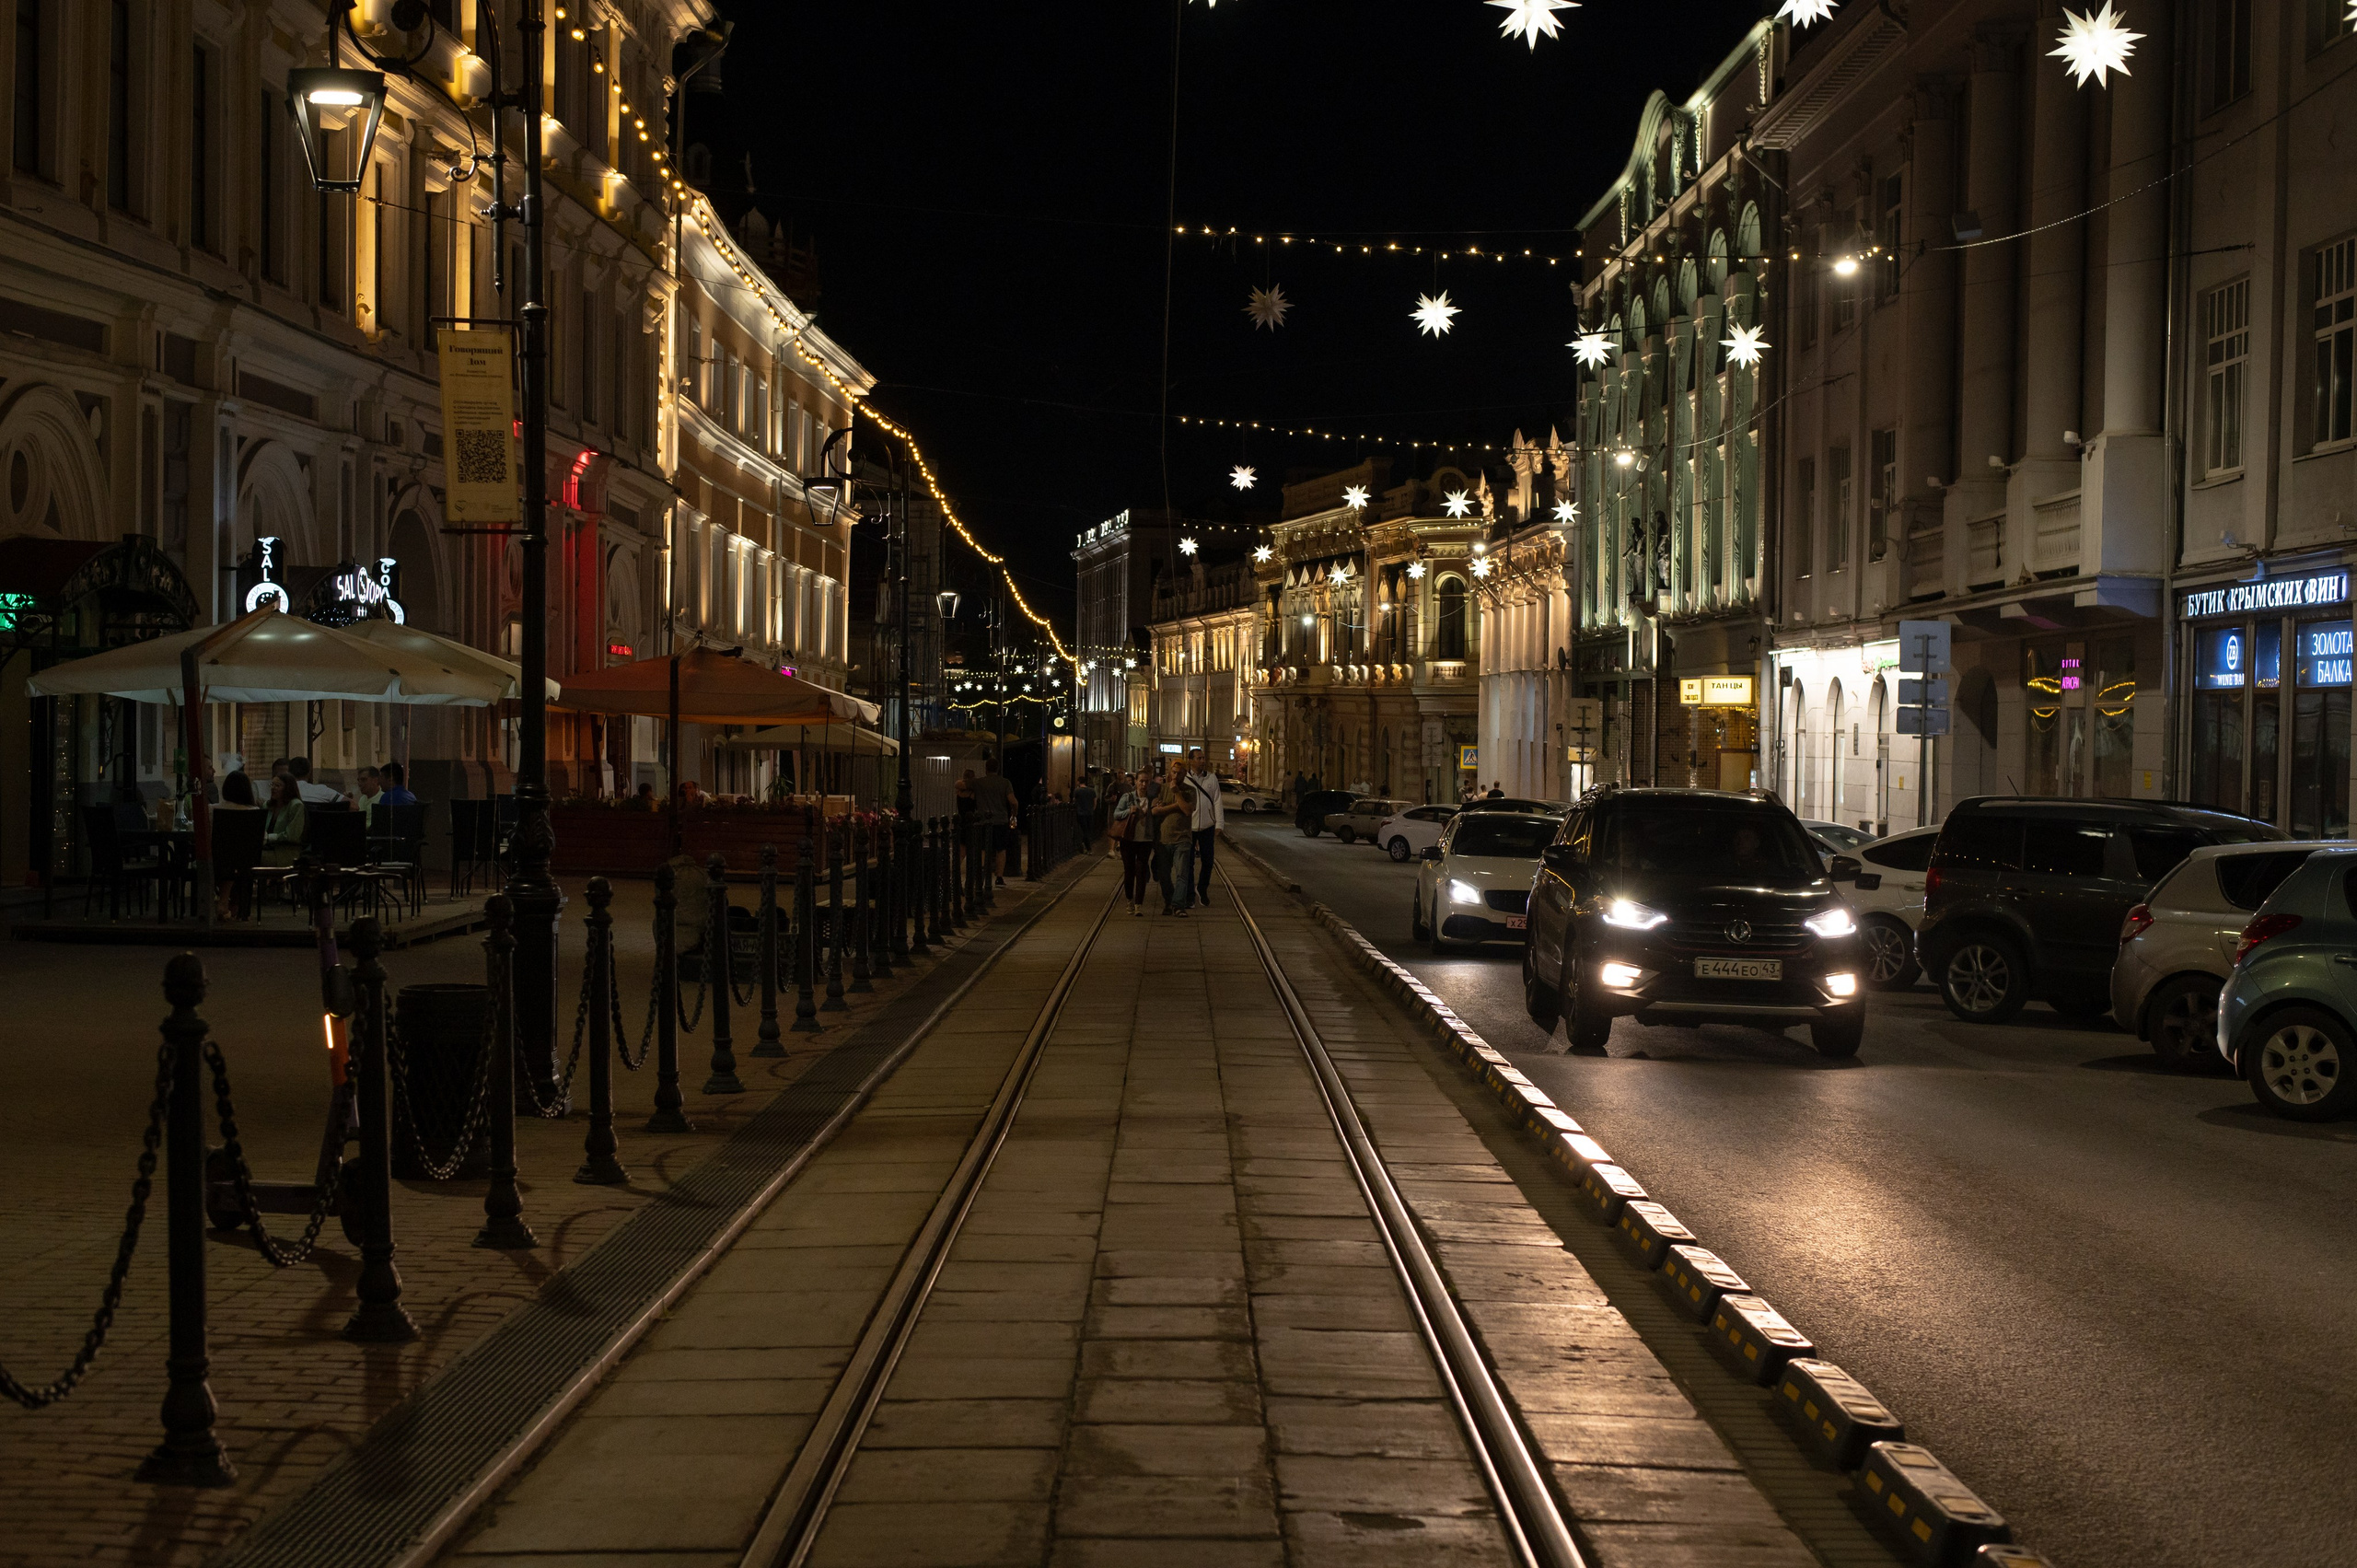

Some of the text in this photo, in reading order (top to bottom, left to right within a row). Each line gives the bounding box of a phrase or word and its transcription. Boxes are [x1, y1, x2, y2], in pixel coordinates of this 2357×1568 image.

[448, 344, 504, 355] Говорящий
[467, 357, 486, 366] Дом
[261, 542, 273, 582] SAL
[2188, 575, 2340, 617] БУТИК КРЫМСКИХ ВИН
[2312, 631, 2353, 656] ЗОЛОТА
[2061, 658, 2080, 668] БУТИК
[2317, 659, 2352, 683] БАЛКА
[2217, 674, 2233, 685] WINE
[1762, 963, 1776, 974] 43
